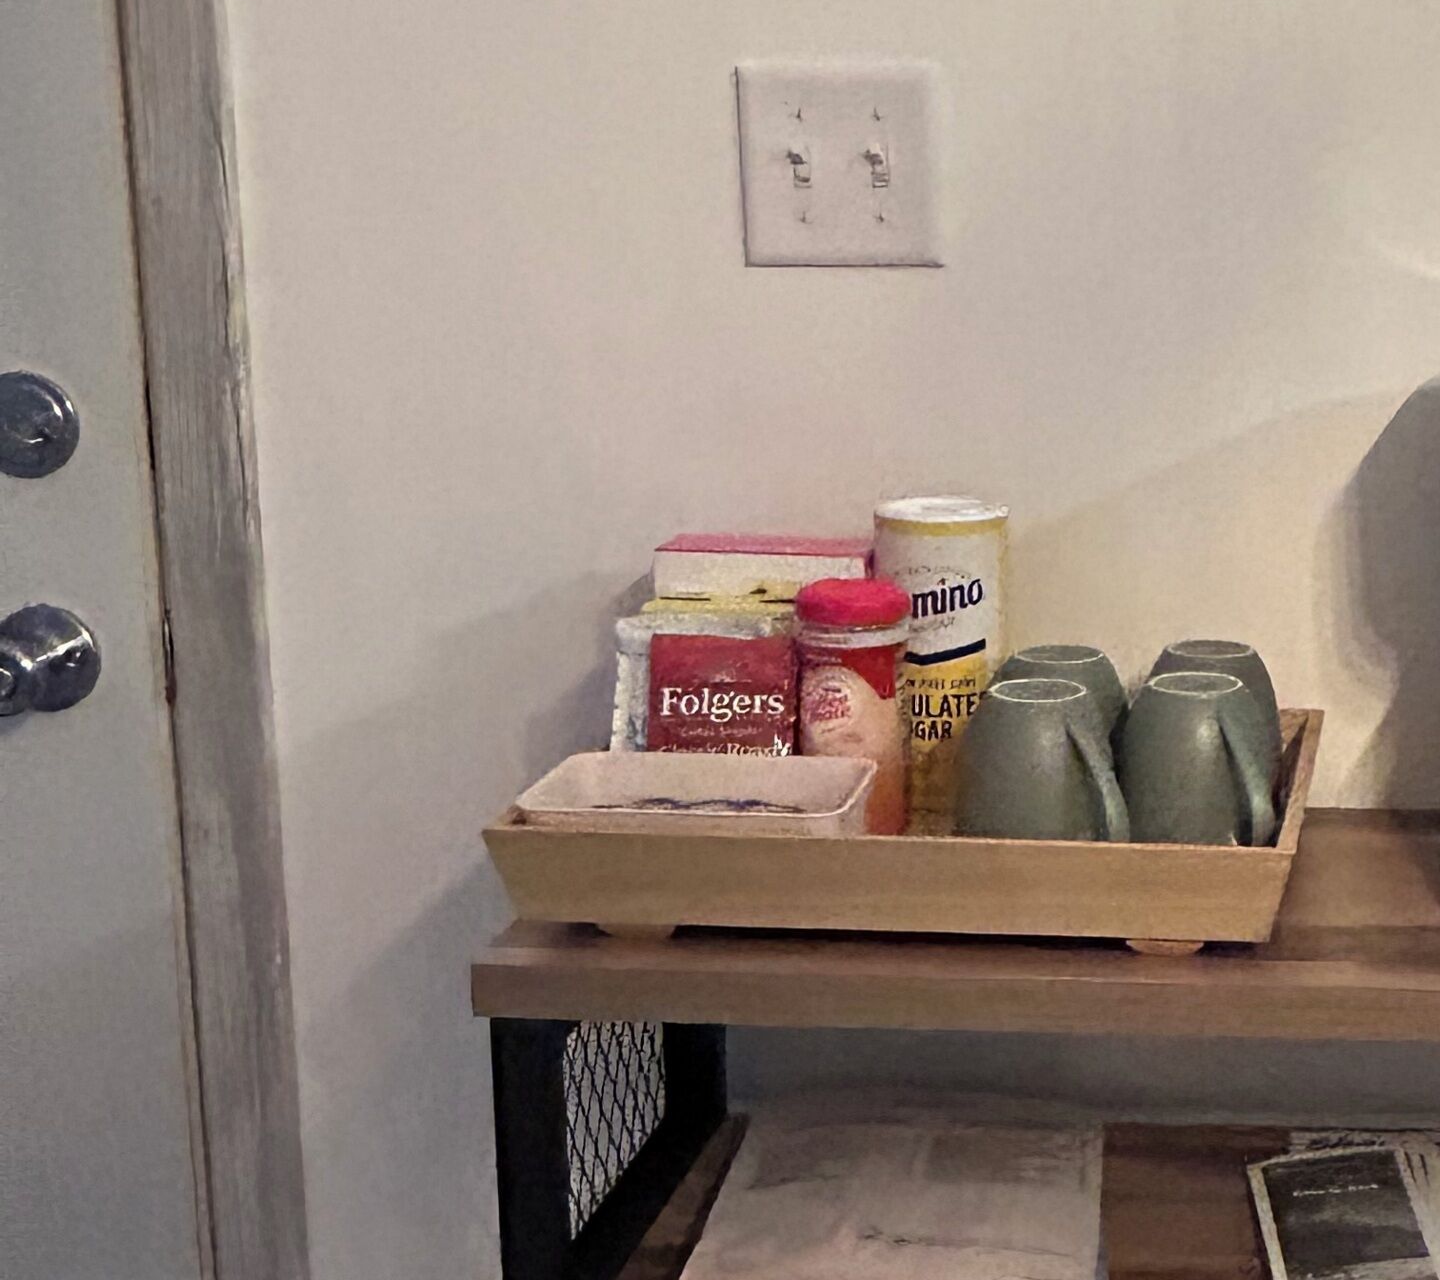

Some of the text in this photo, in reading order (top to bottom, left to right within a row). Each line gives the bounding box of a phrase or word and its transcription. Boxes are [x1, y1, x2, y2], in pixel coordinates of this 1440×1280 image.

[911, 578, 984, 620] mino
[660, 687, 785, 723] Folgers
[911, 693, 979, 718] ULATE
[911, 720, 953, 742] GAR
